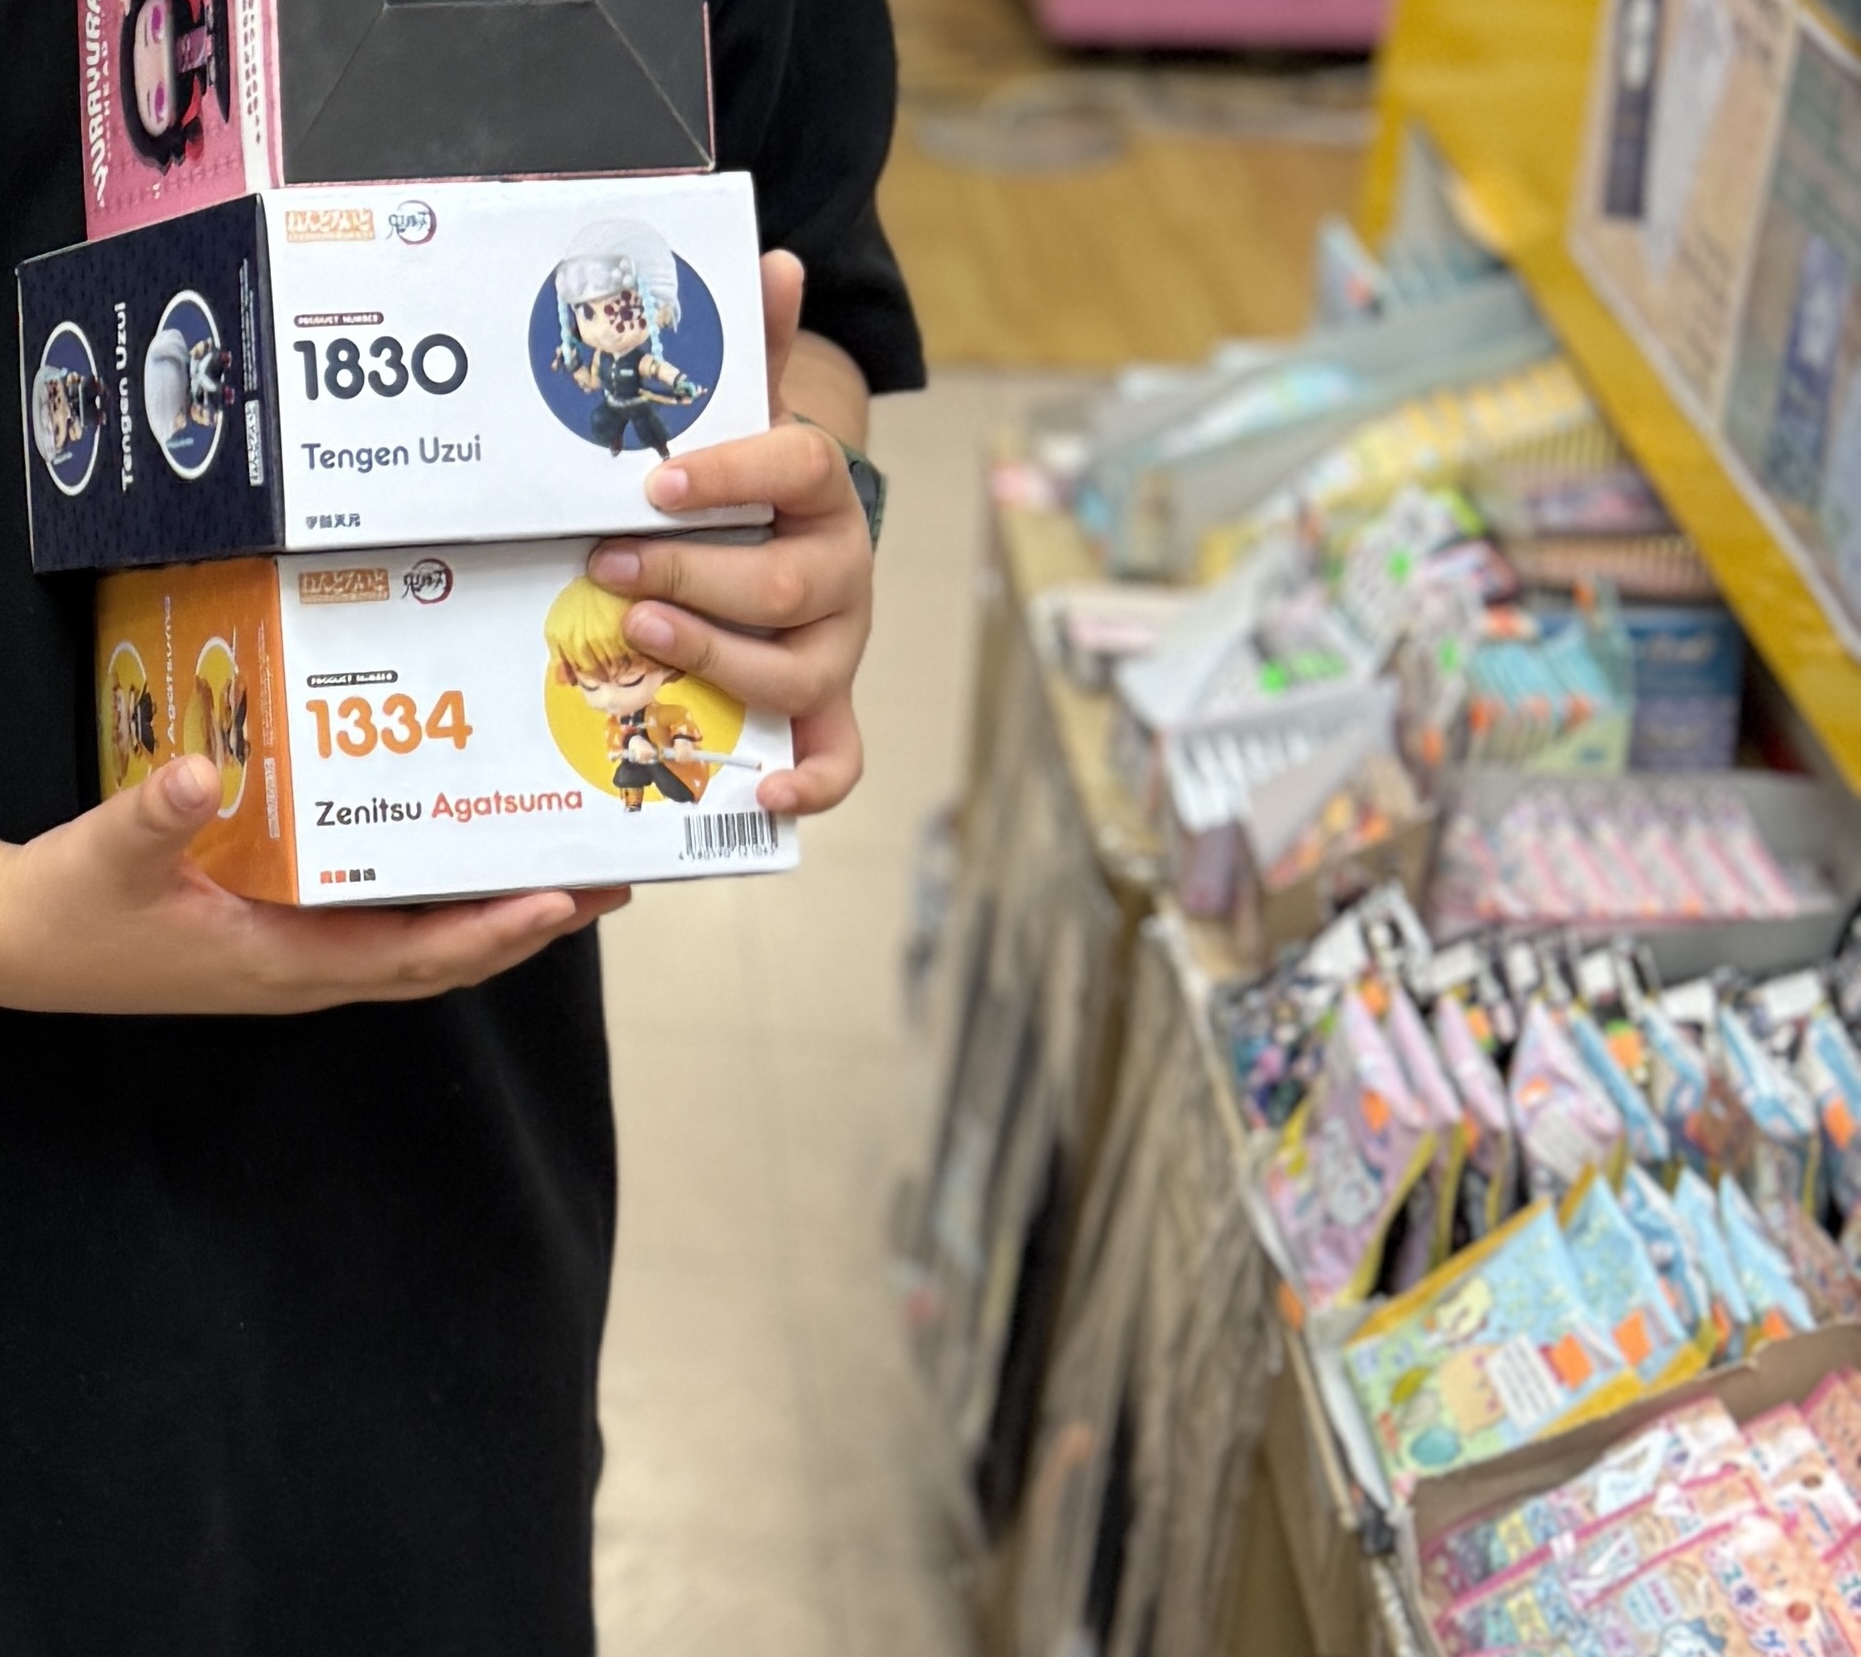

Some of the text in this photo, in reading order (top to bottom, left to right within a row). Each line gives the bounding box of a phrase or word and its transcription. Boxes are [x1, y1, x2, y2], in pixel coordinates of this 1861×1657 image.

[114, 301, 128, 371] Uzui
[293, 333, 469, 401] 1830
[301, 434, 481, 473] Tengen Uzui
[306, 690, 473, 759] 1334
[315, 790, 583, 826] Zenitsu Agatsuma
